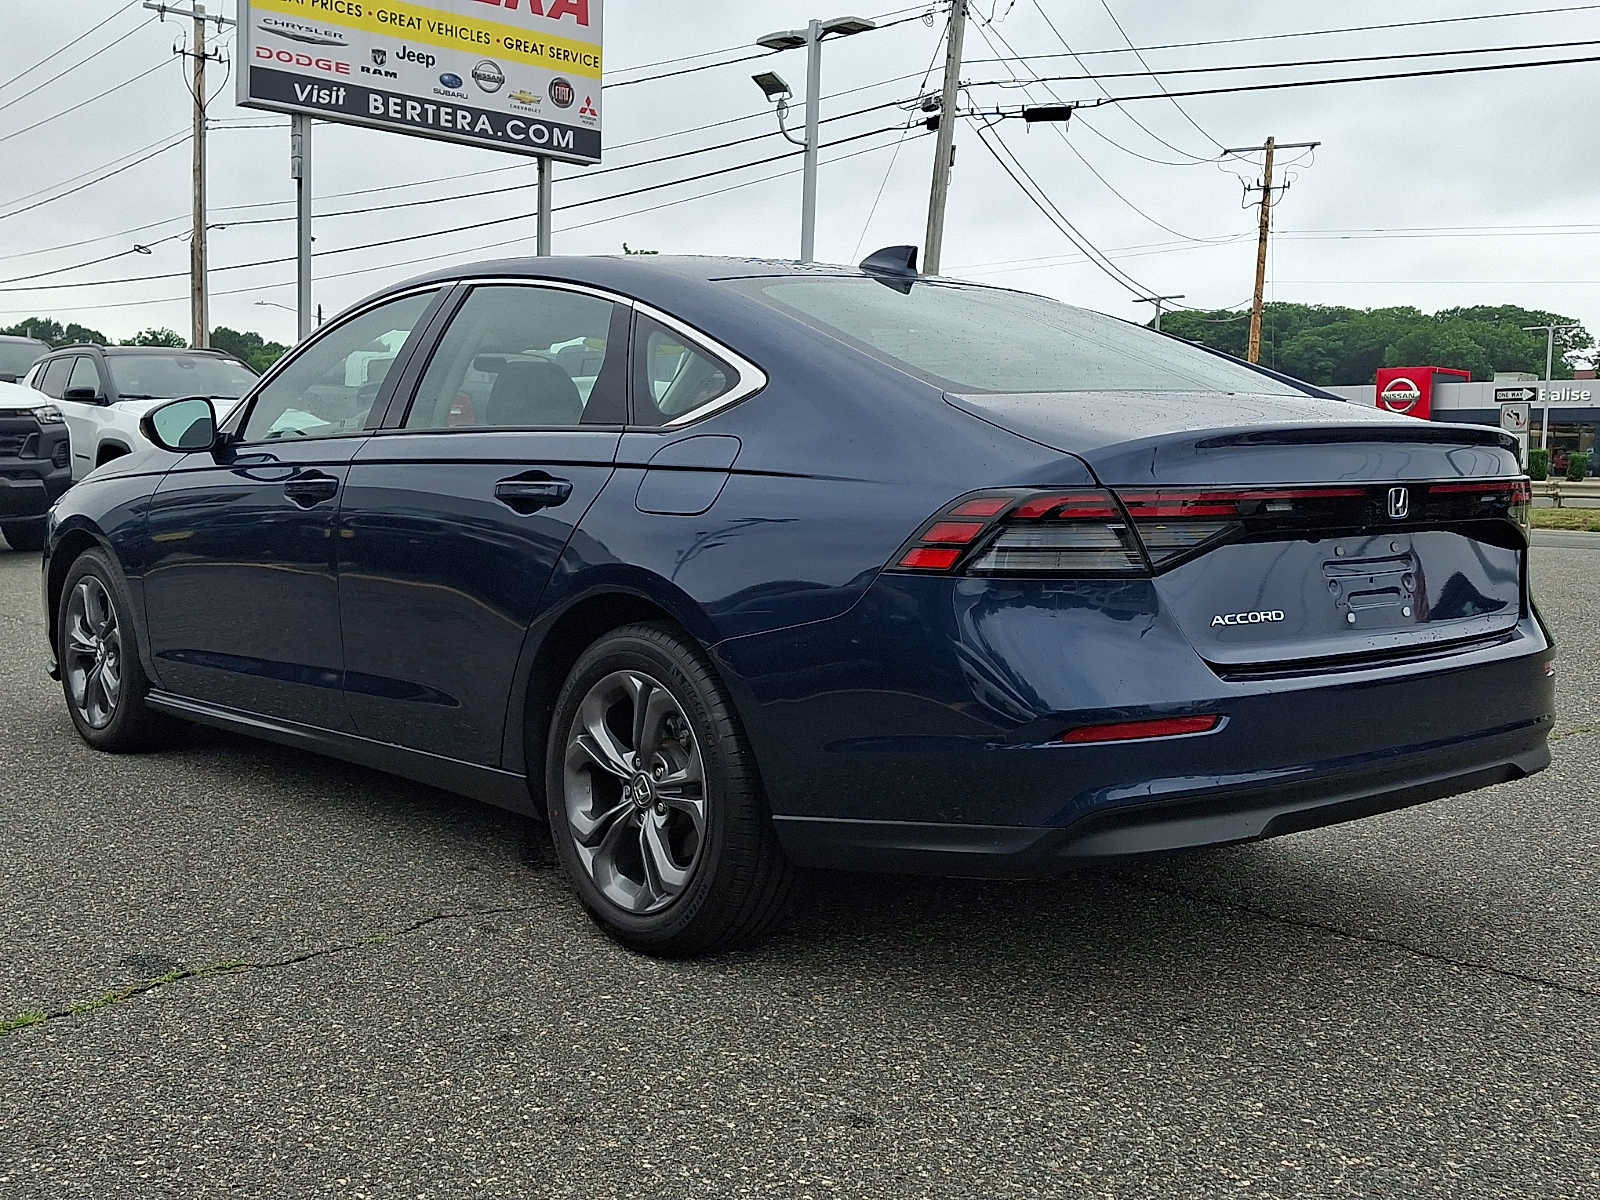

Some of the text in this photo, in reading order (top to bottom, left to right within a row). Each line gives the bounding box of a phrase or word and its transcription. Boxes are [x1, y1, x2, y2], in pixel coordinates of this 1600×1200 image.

[262, 18, 344, 39] CHRYSLER
[376, 9, 423, 31] GREAT
[426, 19, 491, 45] VEHICLES
[503, 36, 545, 57] GREAT
[548, 45, 600, 68] SERVICE
[255, 46, 351, 75] DODGE
[395, 45, 436, 68] Jeep
[360, 65, 398, 79] RAM
[432, 87, 469, 100] SUBARU
[554, 85, 570, 102] FIAT
[293, 82, 575, 150] Visit BERTERA.COM
[509, 103, 541, 114] CHEVROLET
[1383, 393, 1415, 401] NISSAN
[1210, 610, 1285, 627] ACCORD
